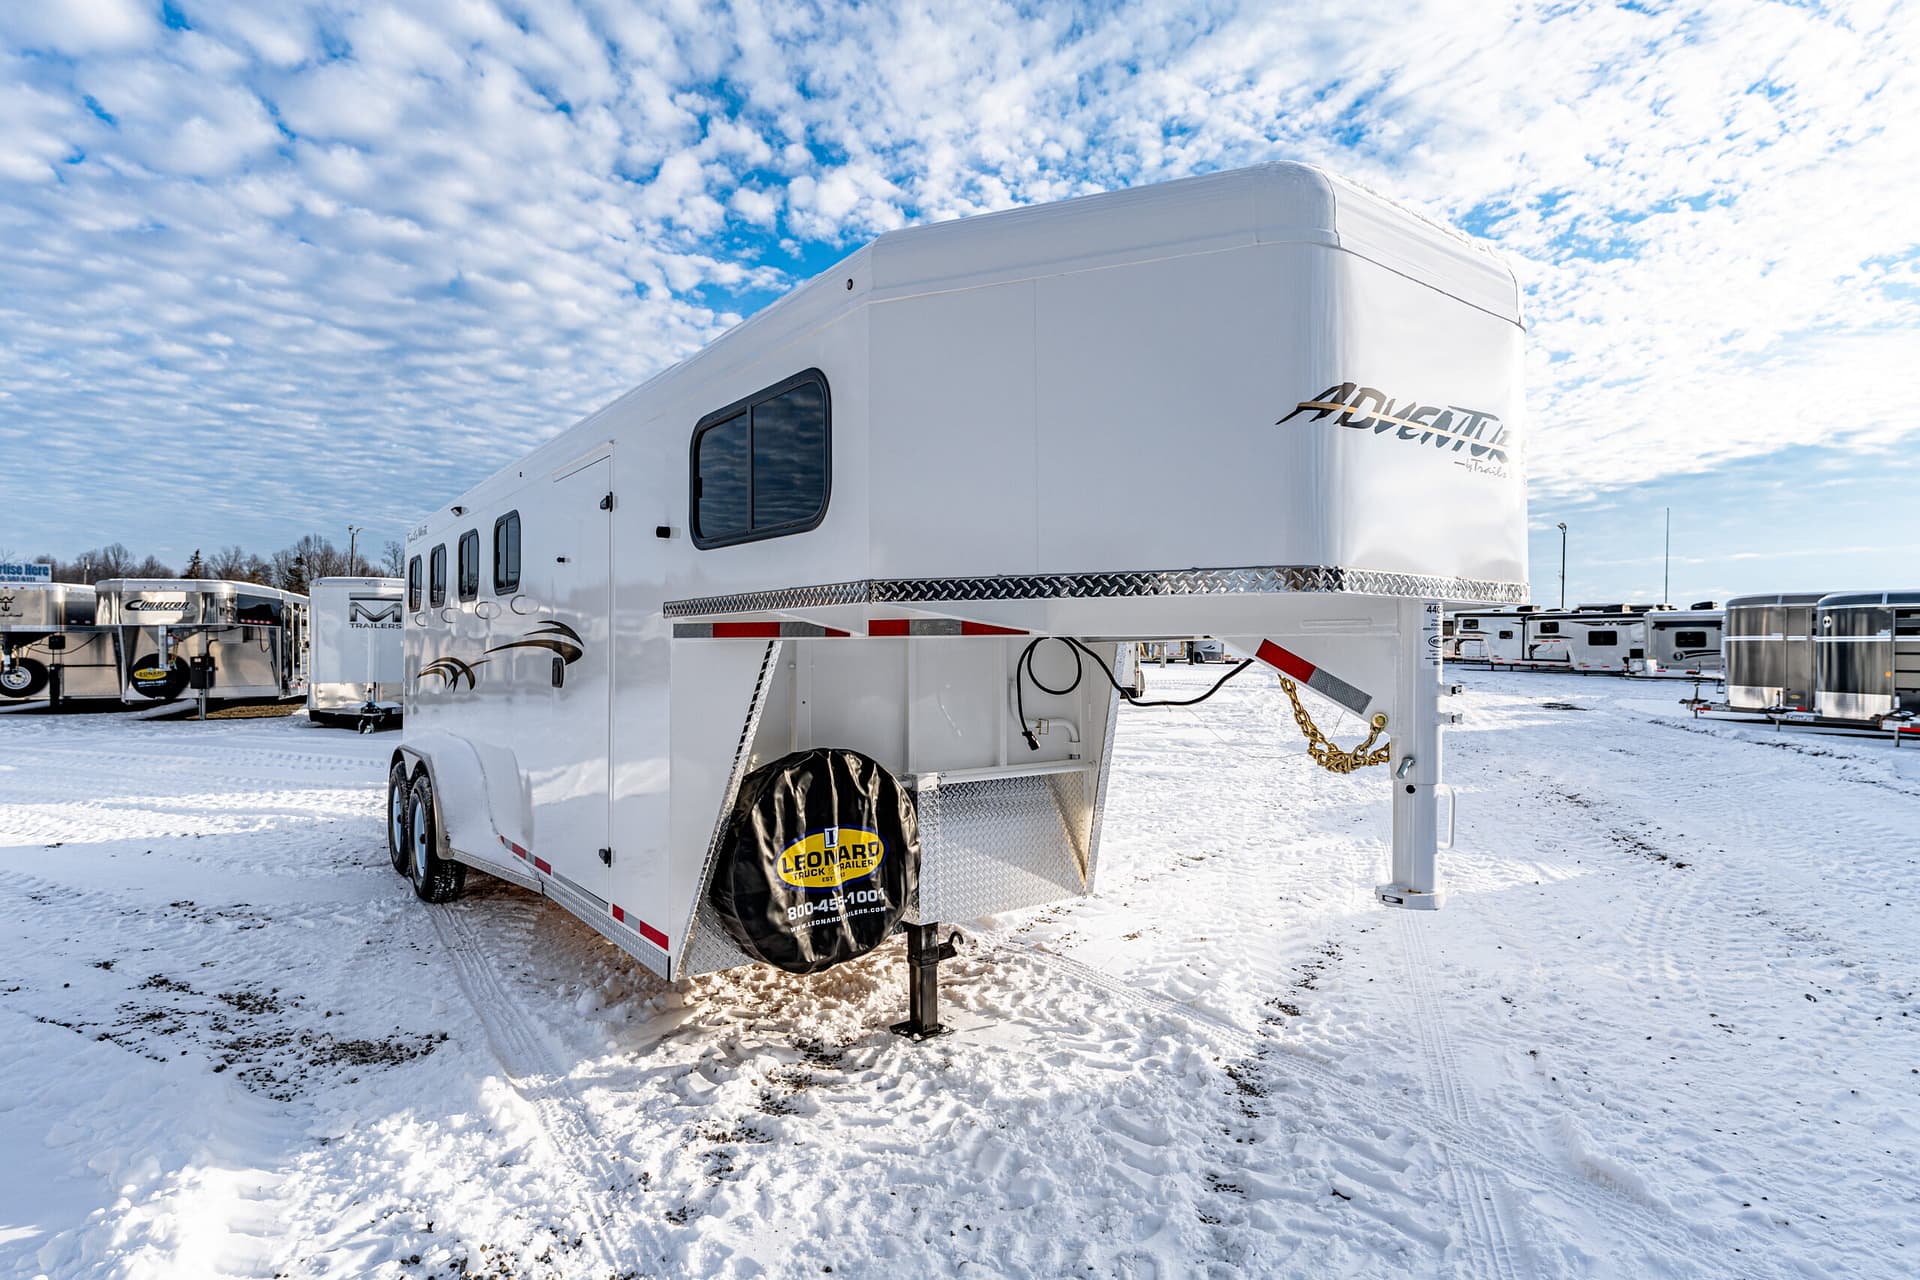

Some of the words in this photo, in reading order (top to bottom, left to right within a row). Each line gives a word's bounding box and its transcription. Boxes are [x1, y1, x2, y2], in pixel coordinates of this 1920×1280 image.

[25, 564, 49, 576] Here
[782, 841, 880, 873] LEONARD
[794, 867, 825, 880] TRUCK
[787, 888, 886, 921] 800-455-1001
[790, 906, 887, 933] WWW.LEONARDAILERS.COM
